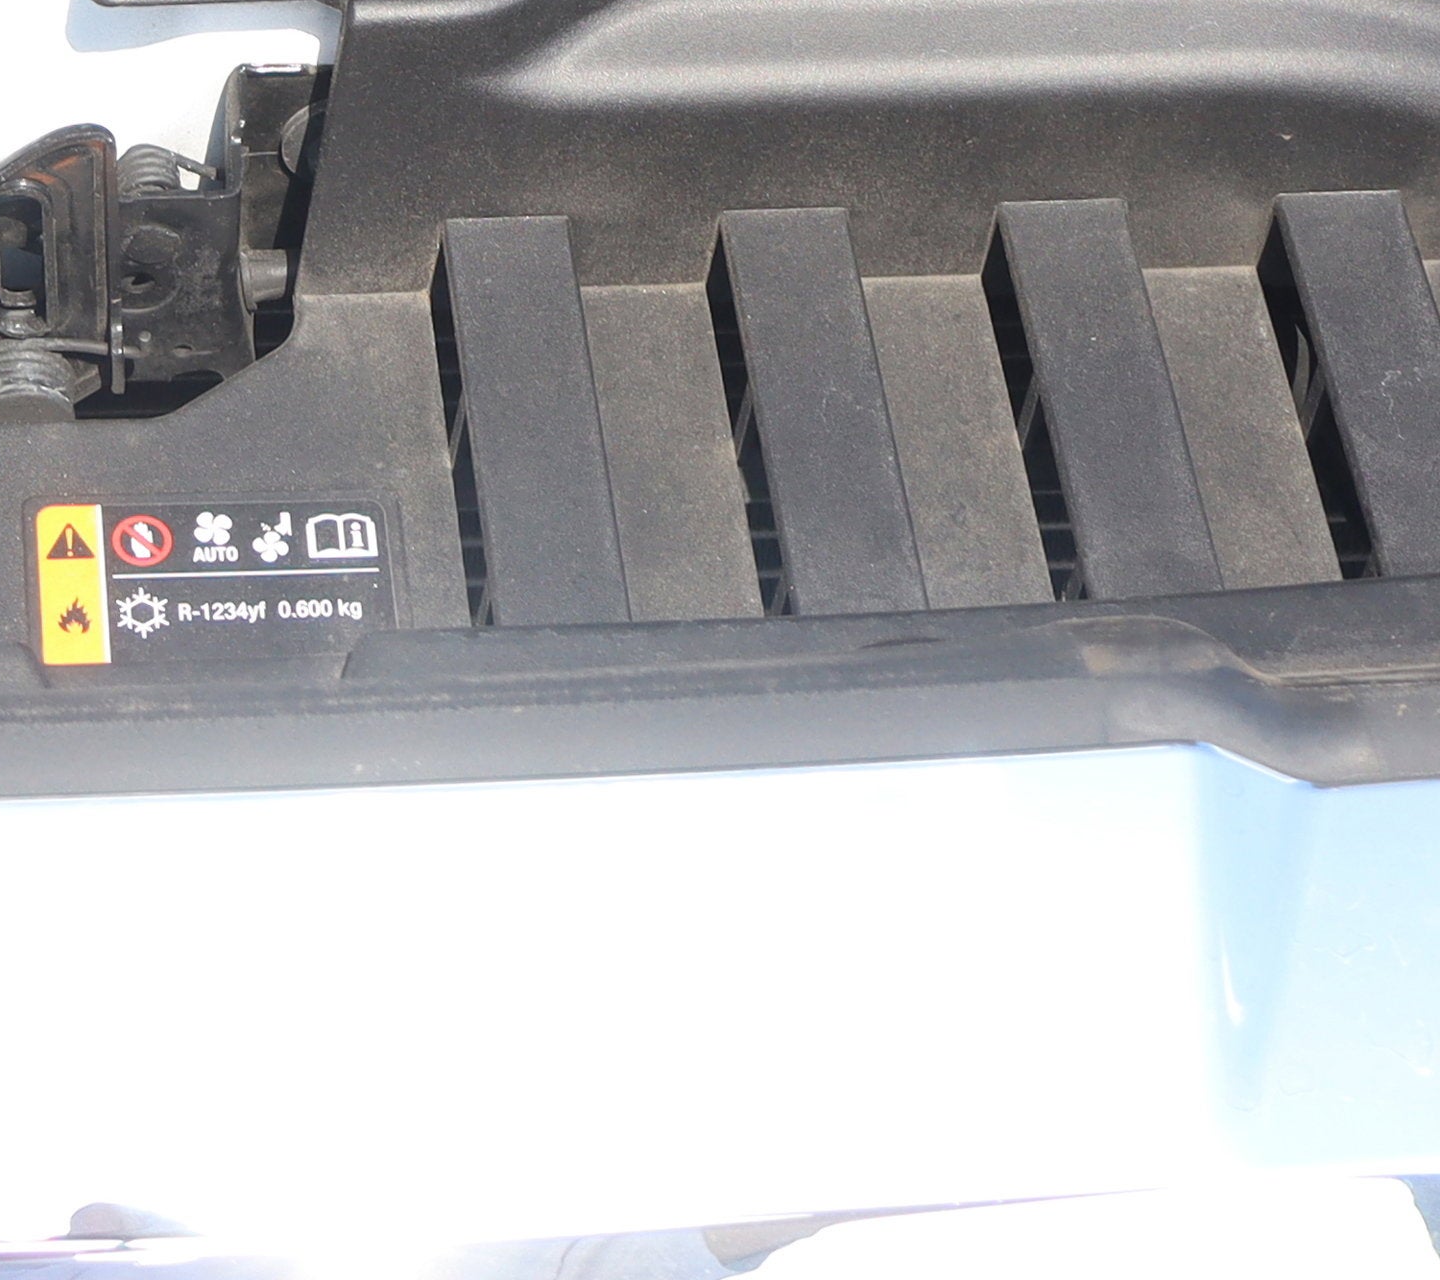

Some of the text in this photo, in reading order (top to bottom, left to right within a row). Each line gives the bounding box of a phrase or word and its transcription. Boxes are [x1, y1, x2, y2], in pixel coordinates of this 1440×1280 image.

[193, 546, 239, 562] AUTO
[177, 598, 363, 624] R-1234yf 0.600 kg
